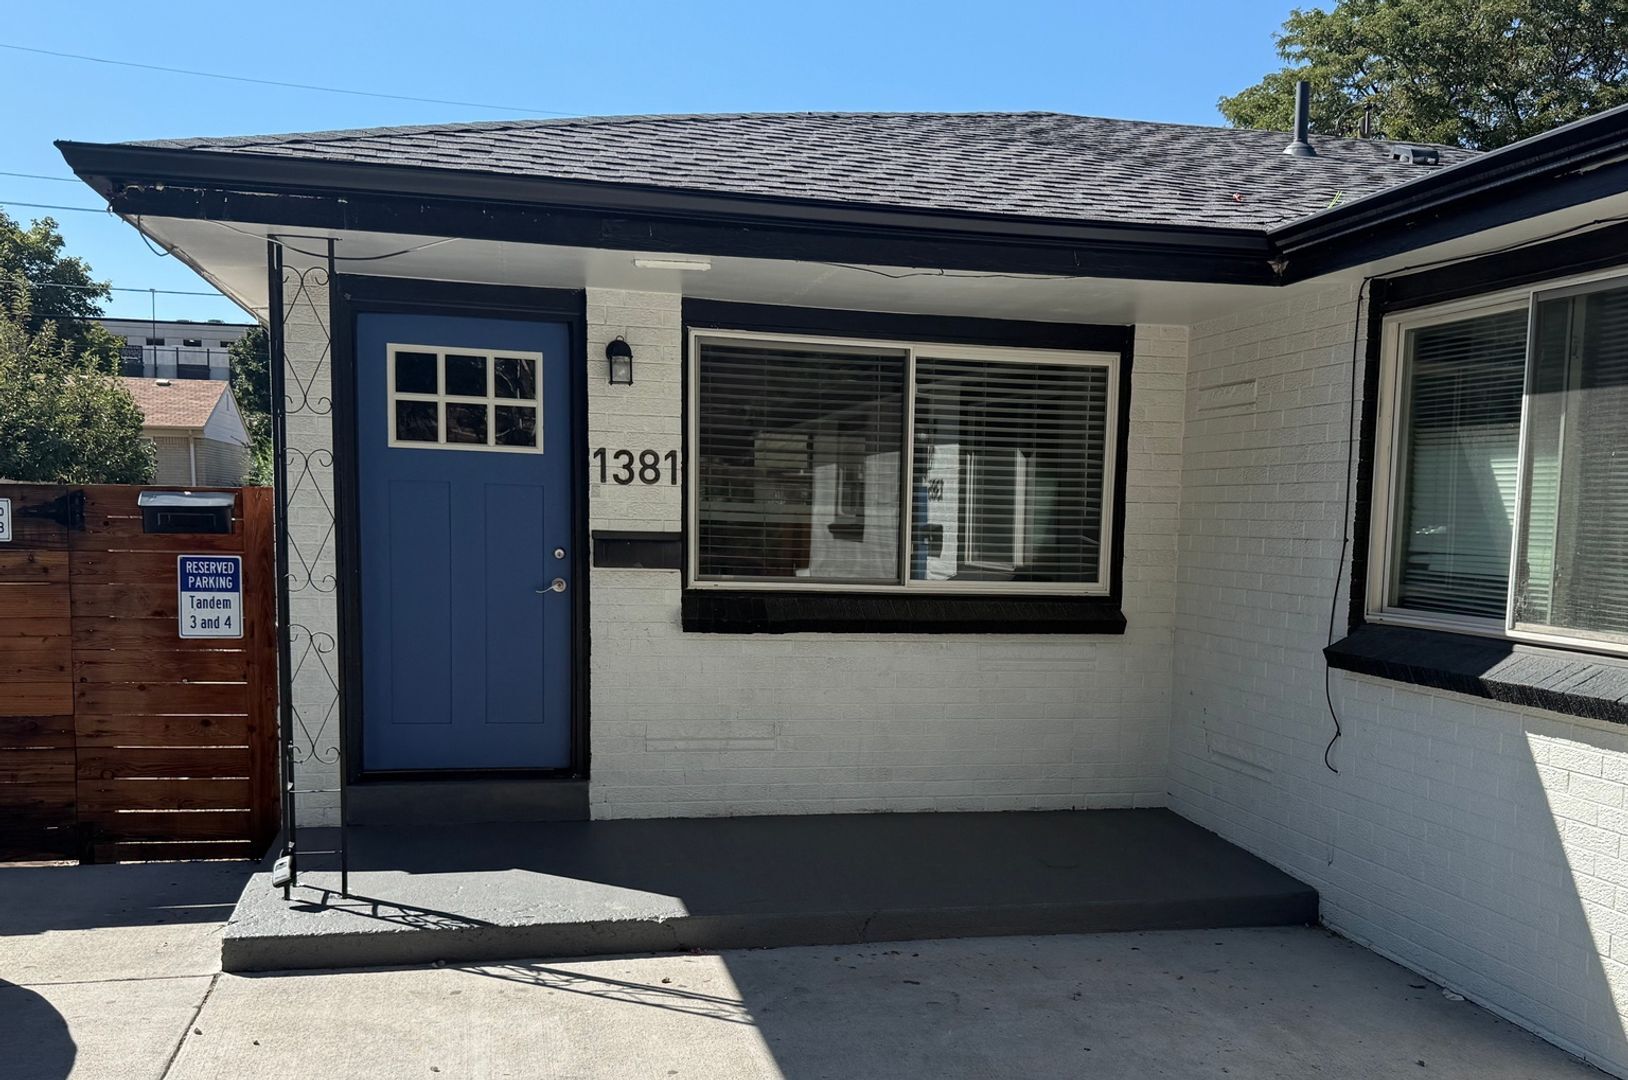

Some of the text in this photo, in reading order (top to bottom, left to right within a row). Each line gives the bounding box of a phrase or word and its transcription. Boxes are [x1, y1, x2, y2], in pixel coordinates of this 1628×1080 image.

[593, 447, 677, 485] 1381
[186, 561, 234, 574] RESERVED
[188, 576, 233, 588] PARKING
[189, 596, 232, 609] Tandem
[190, 615, 232, 628] 3 and 4
